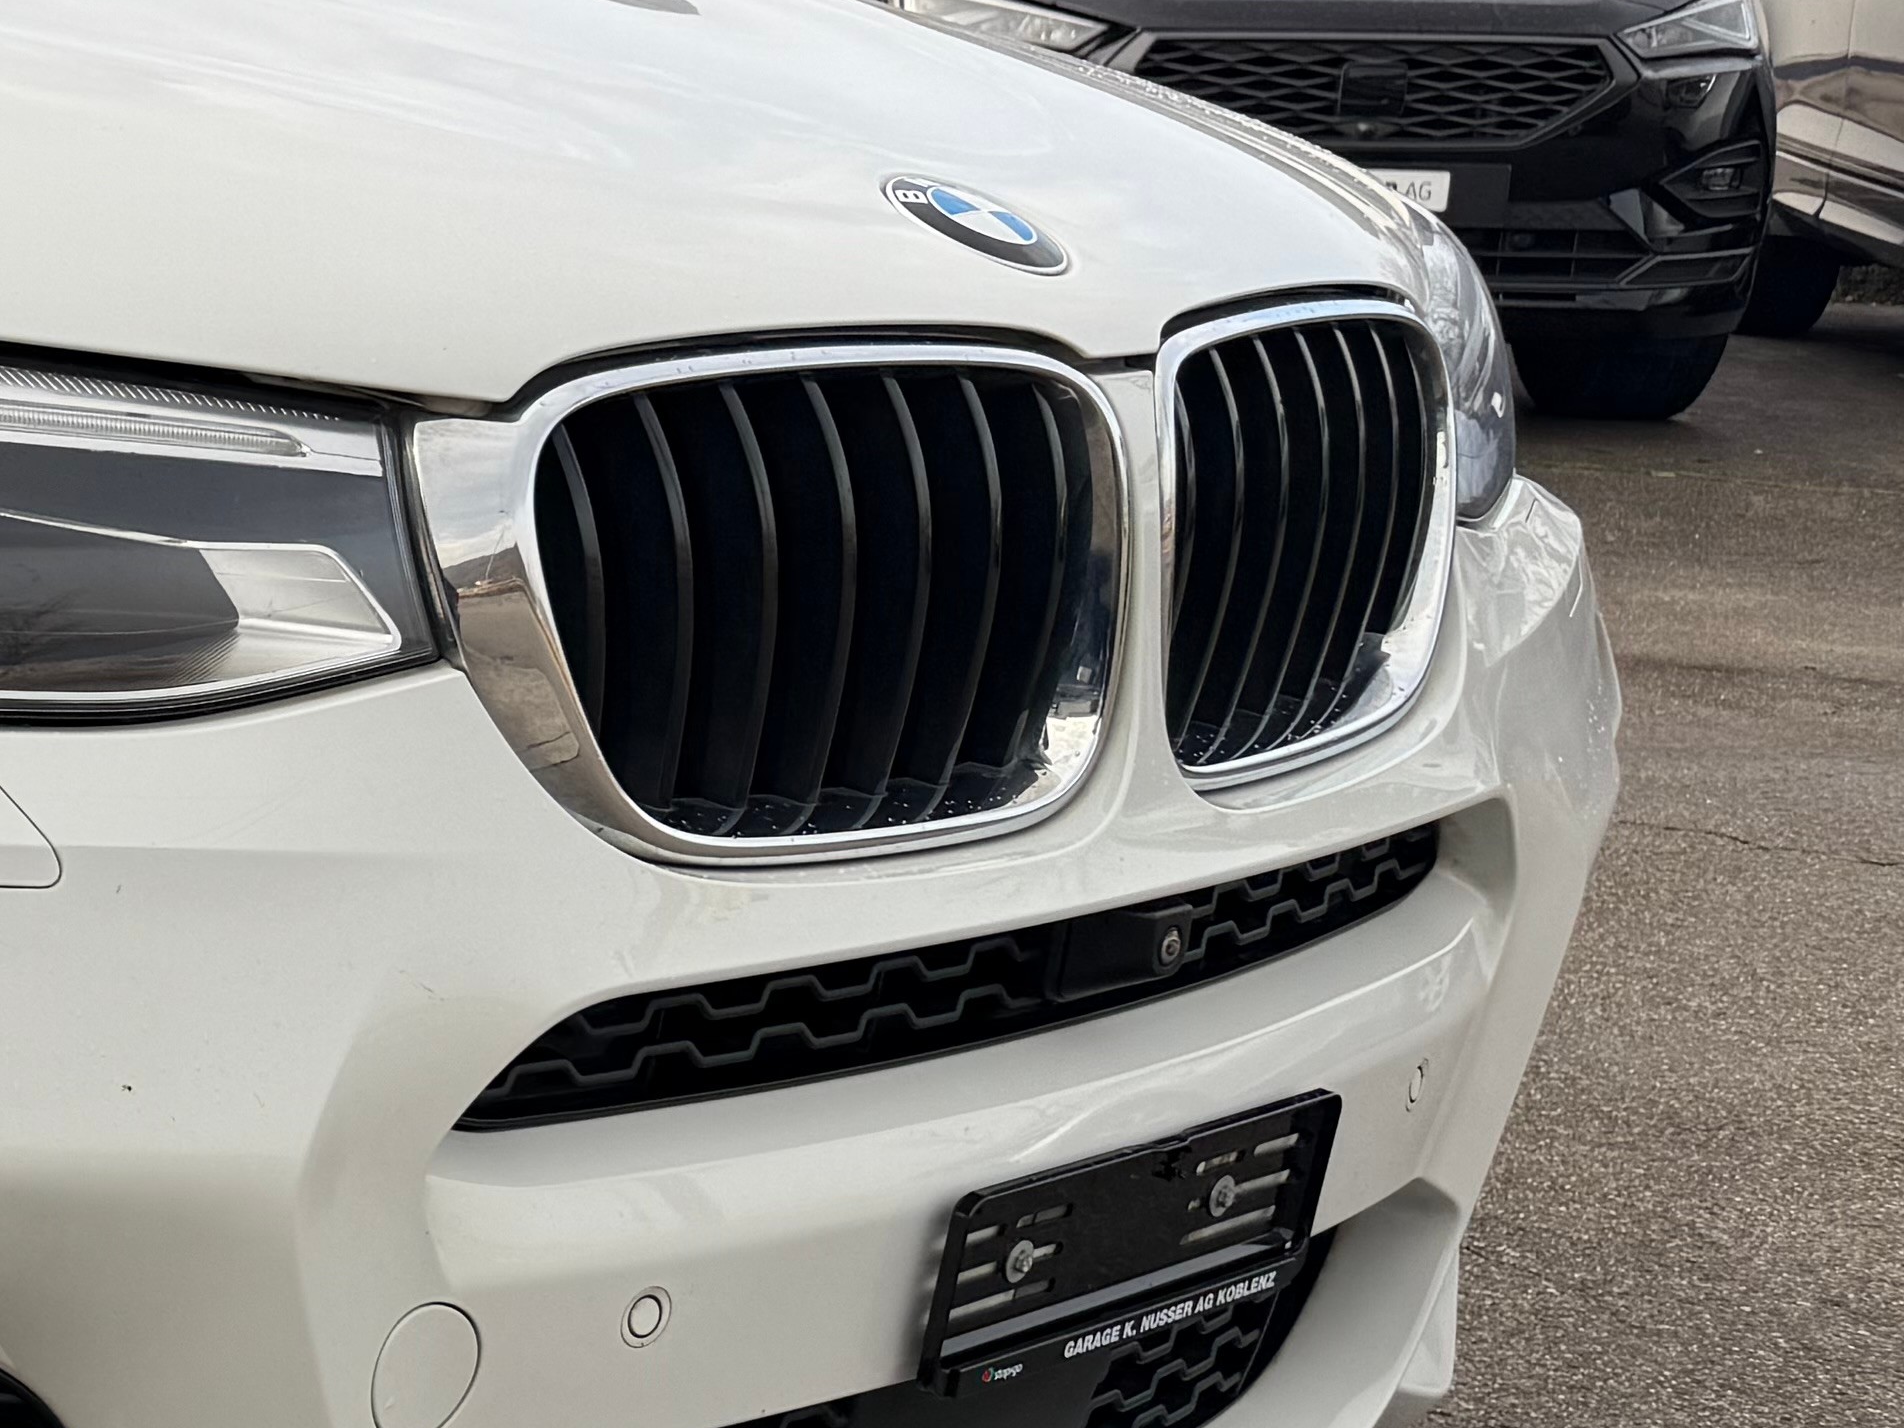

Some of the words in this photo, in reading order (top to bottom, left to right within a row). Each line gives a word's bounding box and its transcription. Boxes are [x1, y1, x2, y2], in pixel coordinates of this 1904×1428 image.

[1064, 1325, 1120, 1358] GARAGE
[1122, 1320, 1137, 1338] K.
[1140, 1300, 1193, 1332] NUSSER
[1194, 1292, 1214, 1314] AG
[1216, 1271, 1277, 1305] KOBLENZ
